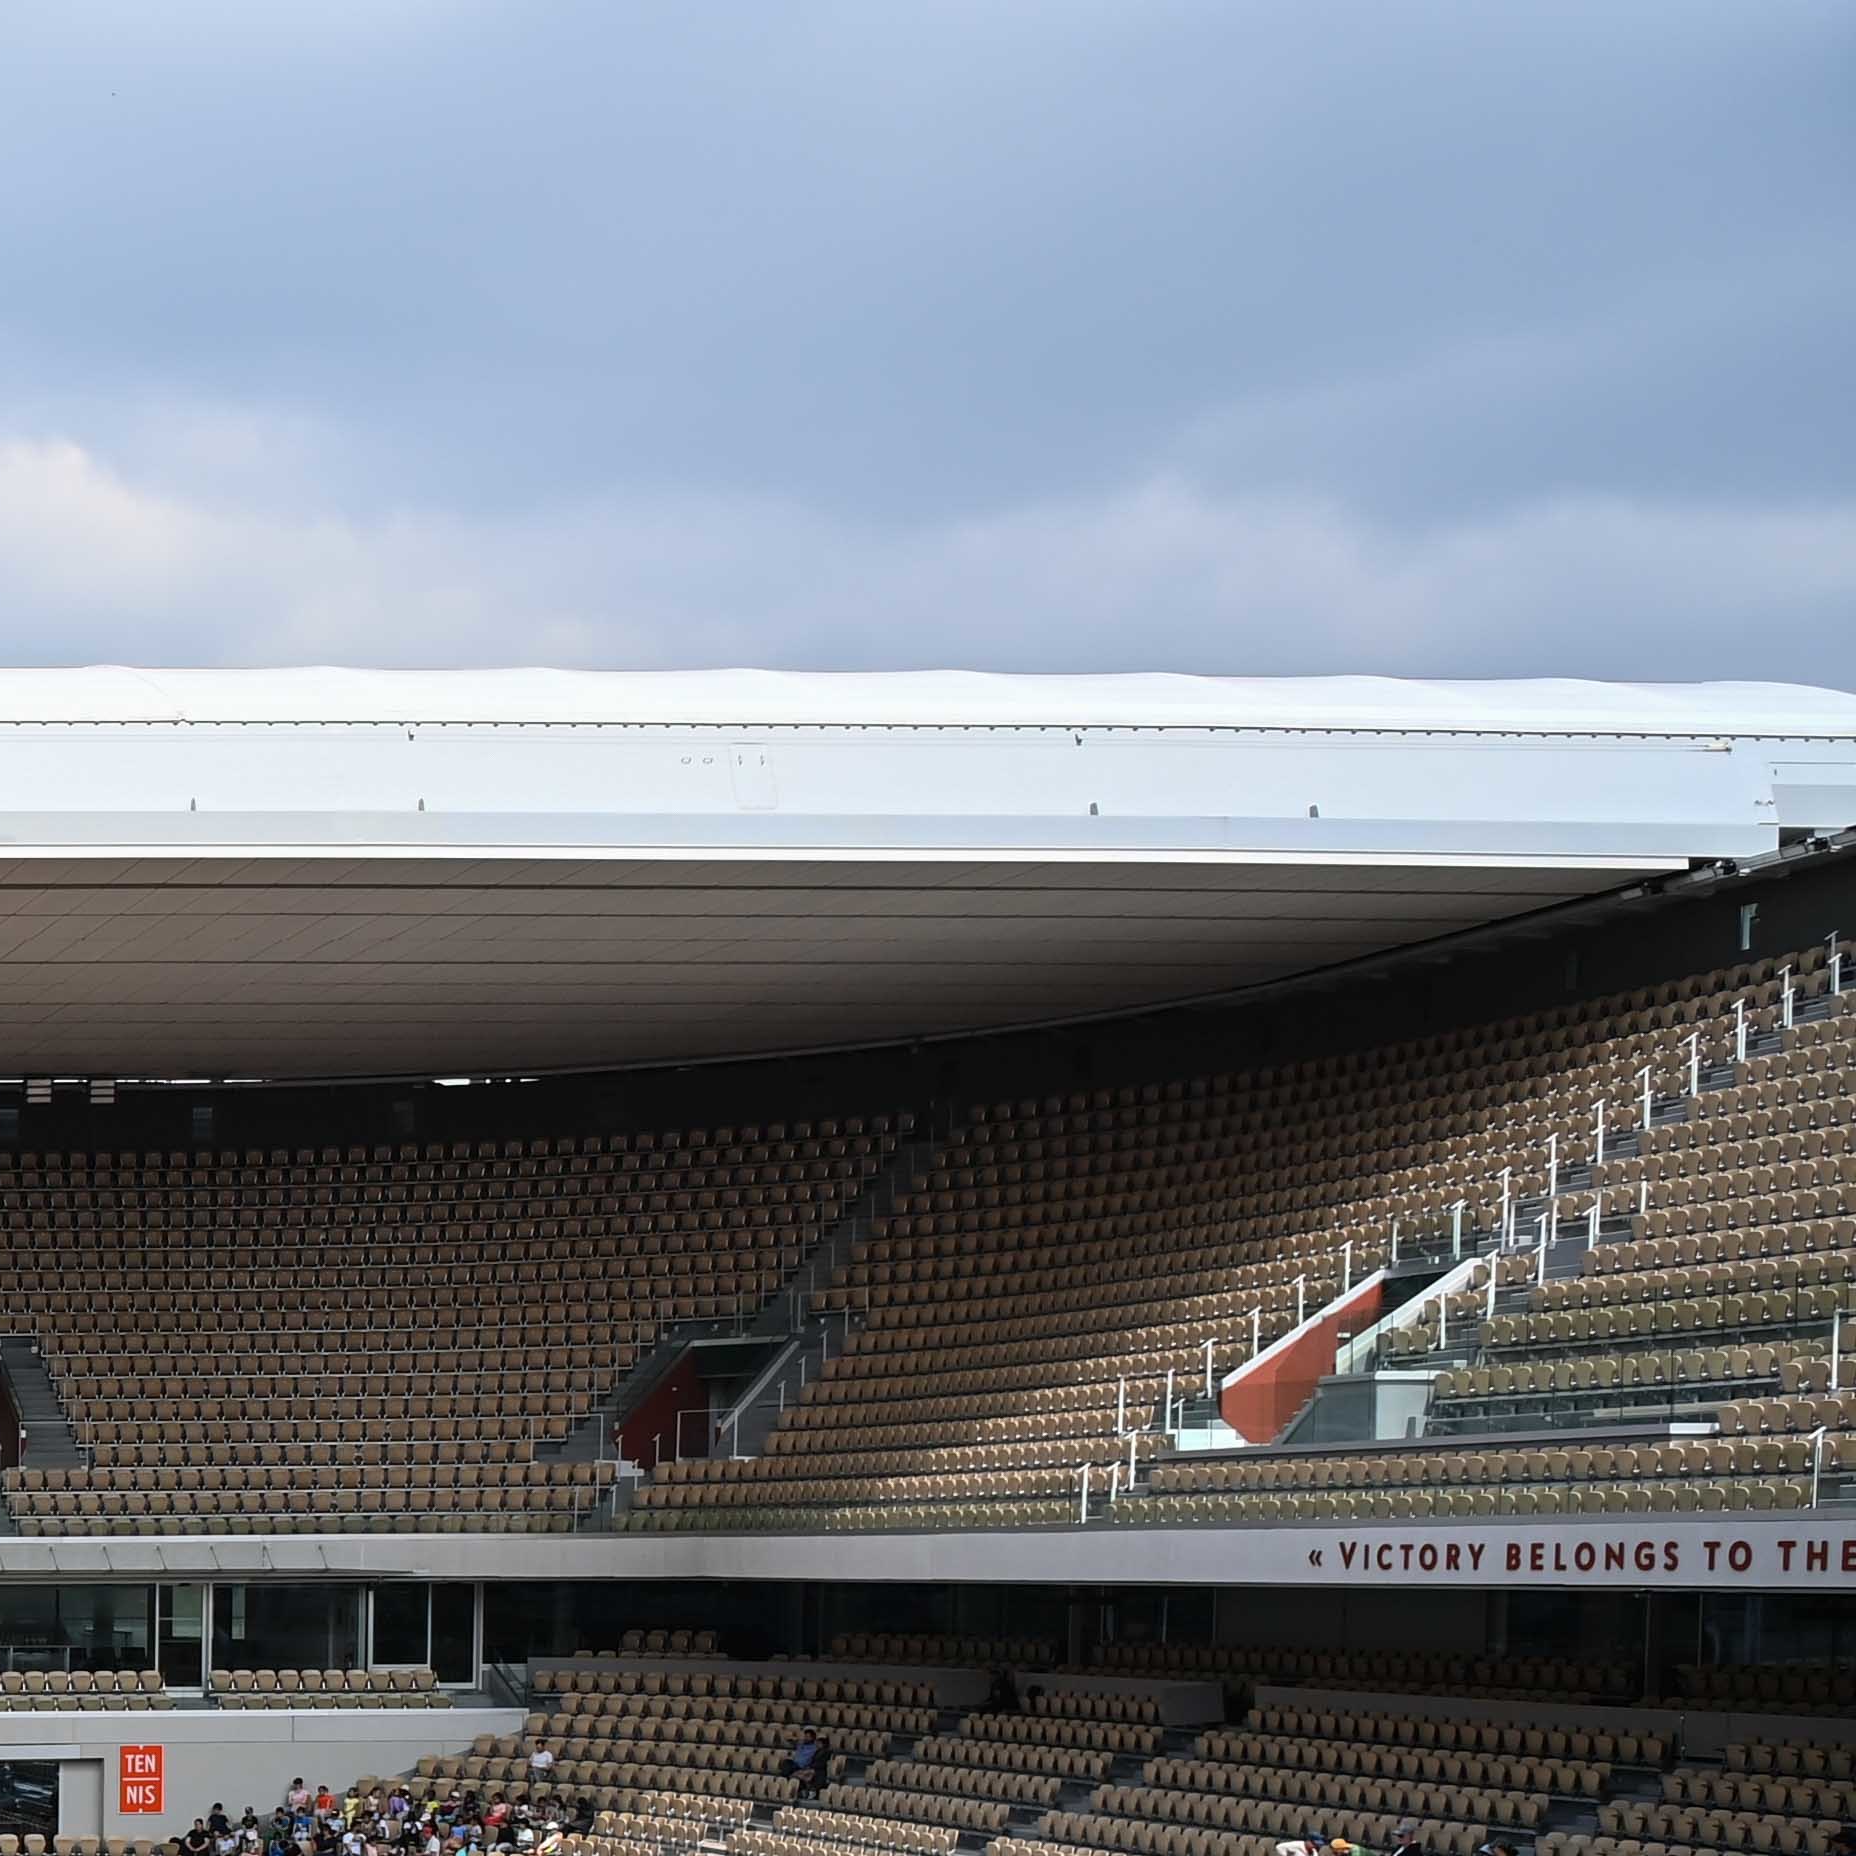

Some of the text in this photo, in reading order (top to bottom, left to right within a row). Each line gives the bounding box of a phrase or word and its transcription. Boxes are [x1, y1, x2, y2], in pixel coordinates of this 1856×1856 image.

[1505, 1542, 1679, 1571] BELONGS
[1703, 1541, 1753, 1571] TO
[1778, 1541, 1856, 1571] THE
[125, 1754, 156, 1773] TEN
[126, 1785, 155, 1804] NIS
